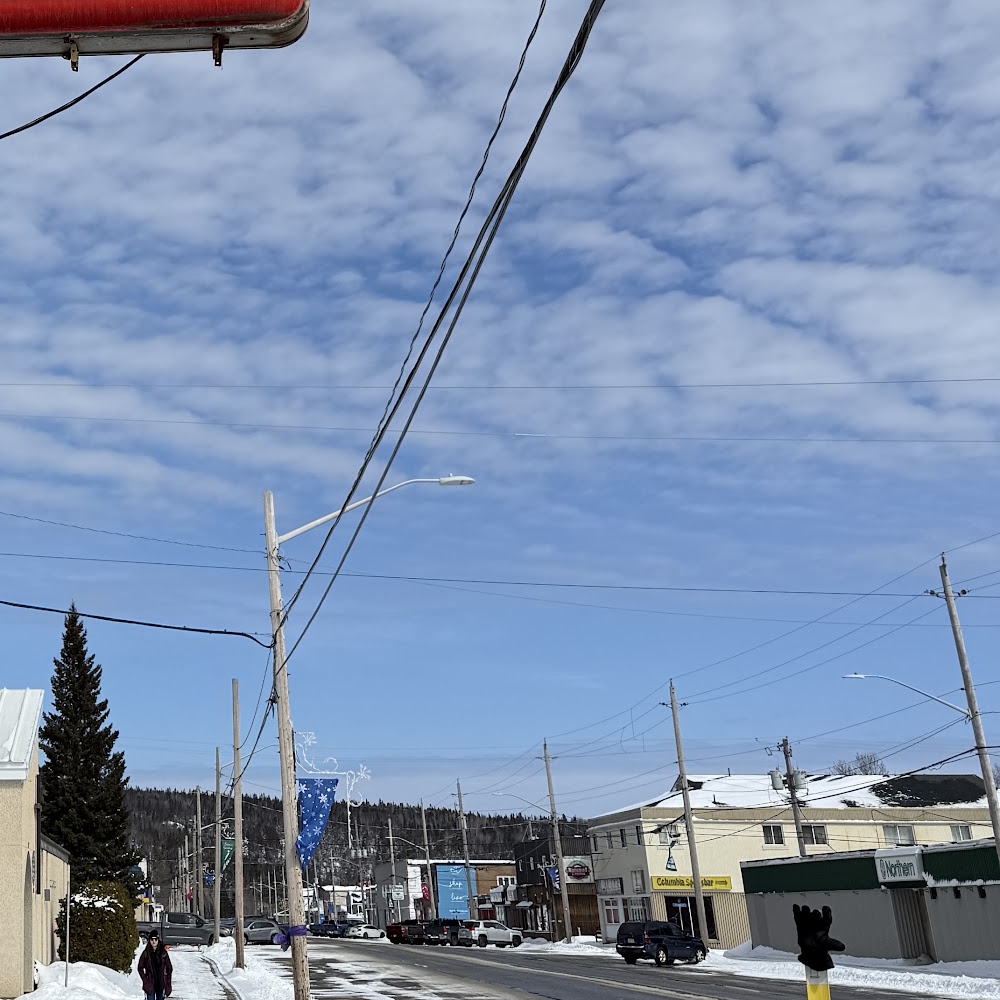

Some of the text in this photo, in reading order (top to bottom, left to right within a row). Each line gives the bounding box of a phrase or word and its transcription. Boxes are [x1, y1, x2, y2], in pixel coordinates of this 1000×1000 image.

[885, 860, 916, 878] Northern
[656, 877, 685, 887] Columbia
[686, 878, 714, 888] Spsbar
